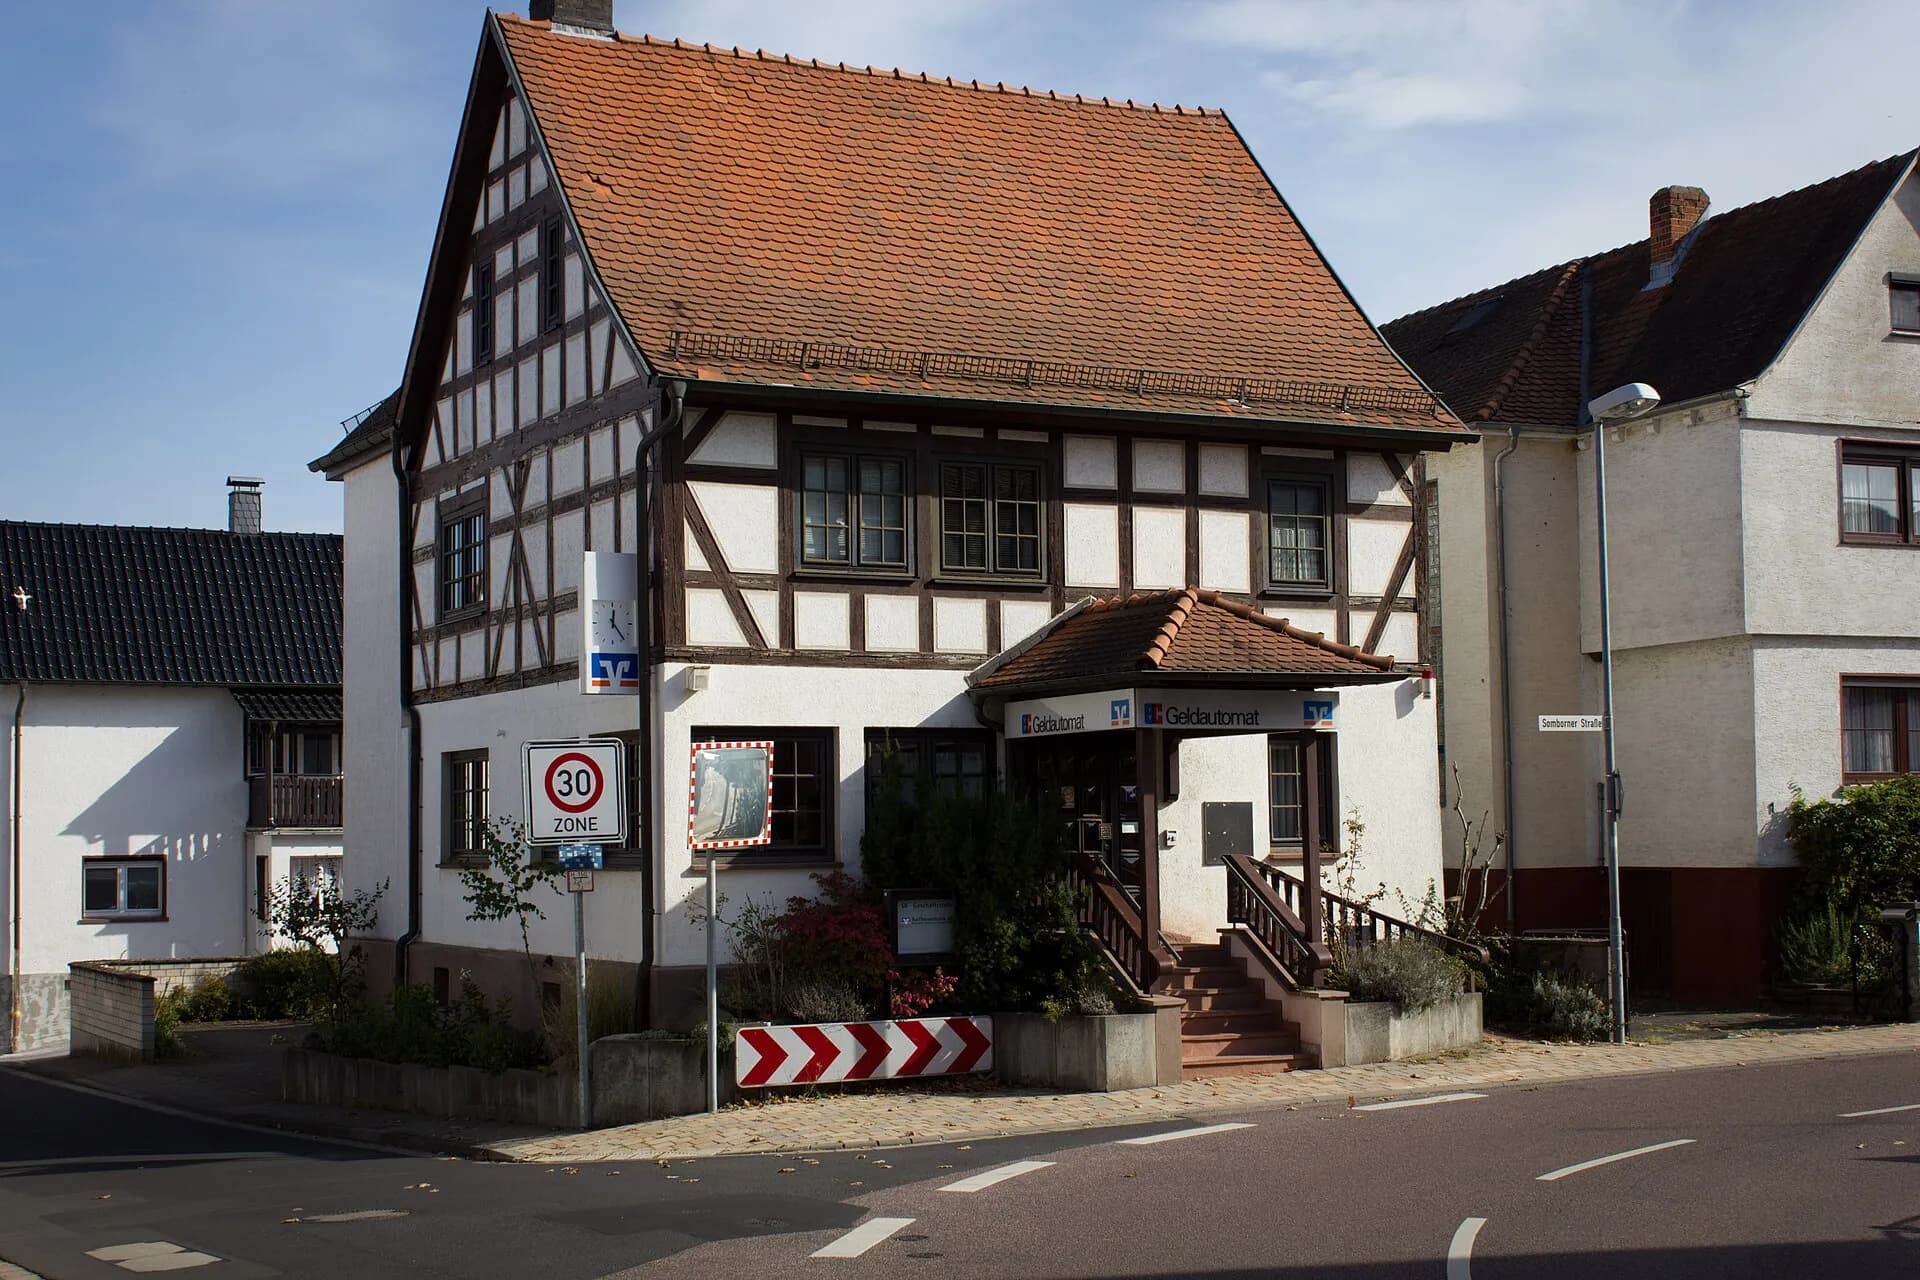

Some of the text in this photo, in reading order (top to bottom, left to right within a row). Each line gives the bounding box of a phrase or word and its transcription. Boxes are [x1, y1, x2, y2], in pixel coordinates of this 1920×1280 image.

[1032, 713, 1085, 734] Geldautomat
[1166, 706, 1260, 726] Geldautomat
[1542, 718, 1578, 728] Somborner
[557, 769, 591, 797] 30
[554, 816, 599, 833] ZONE
